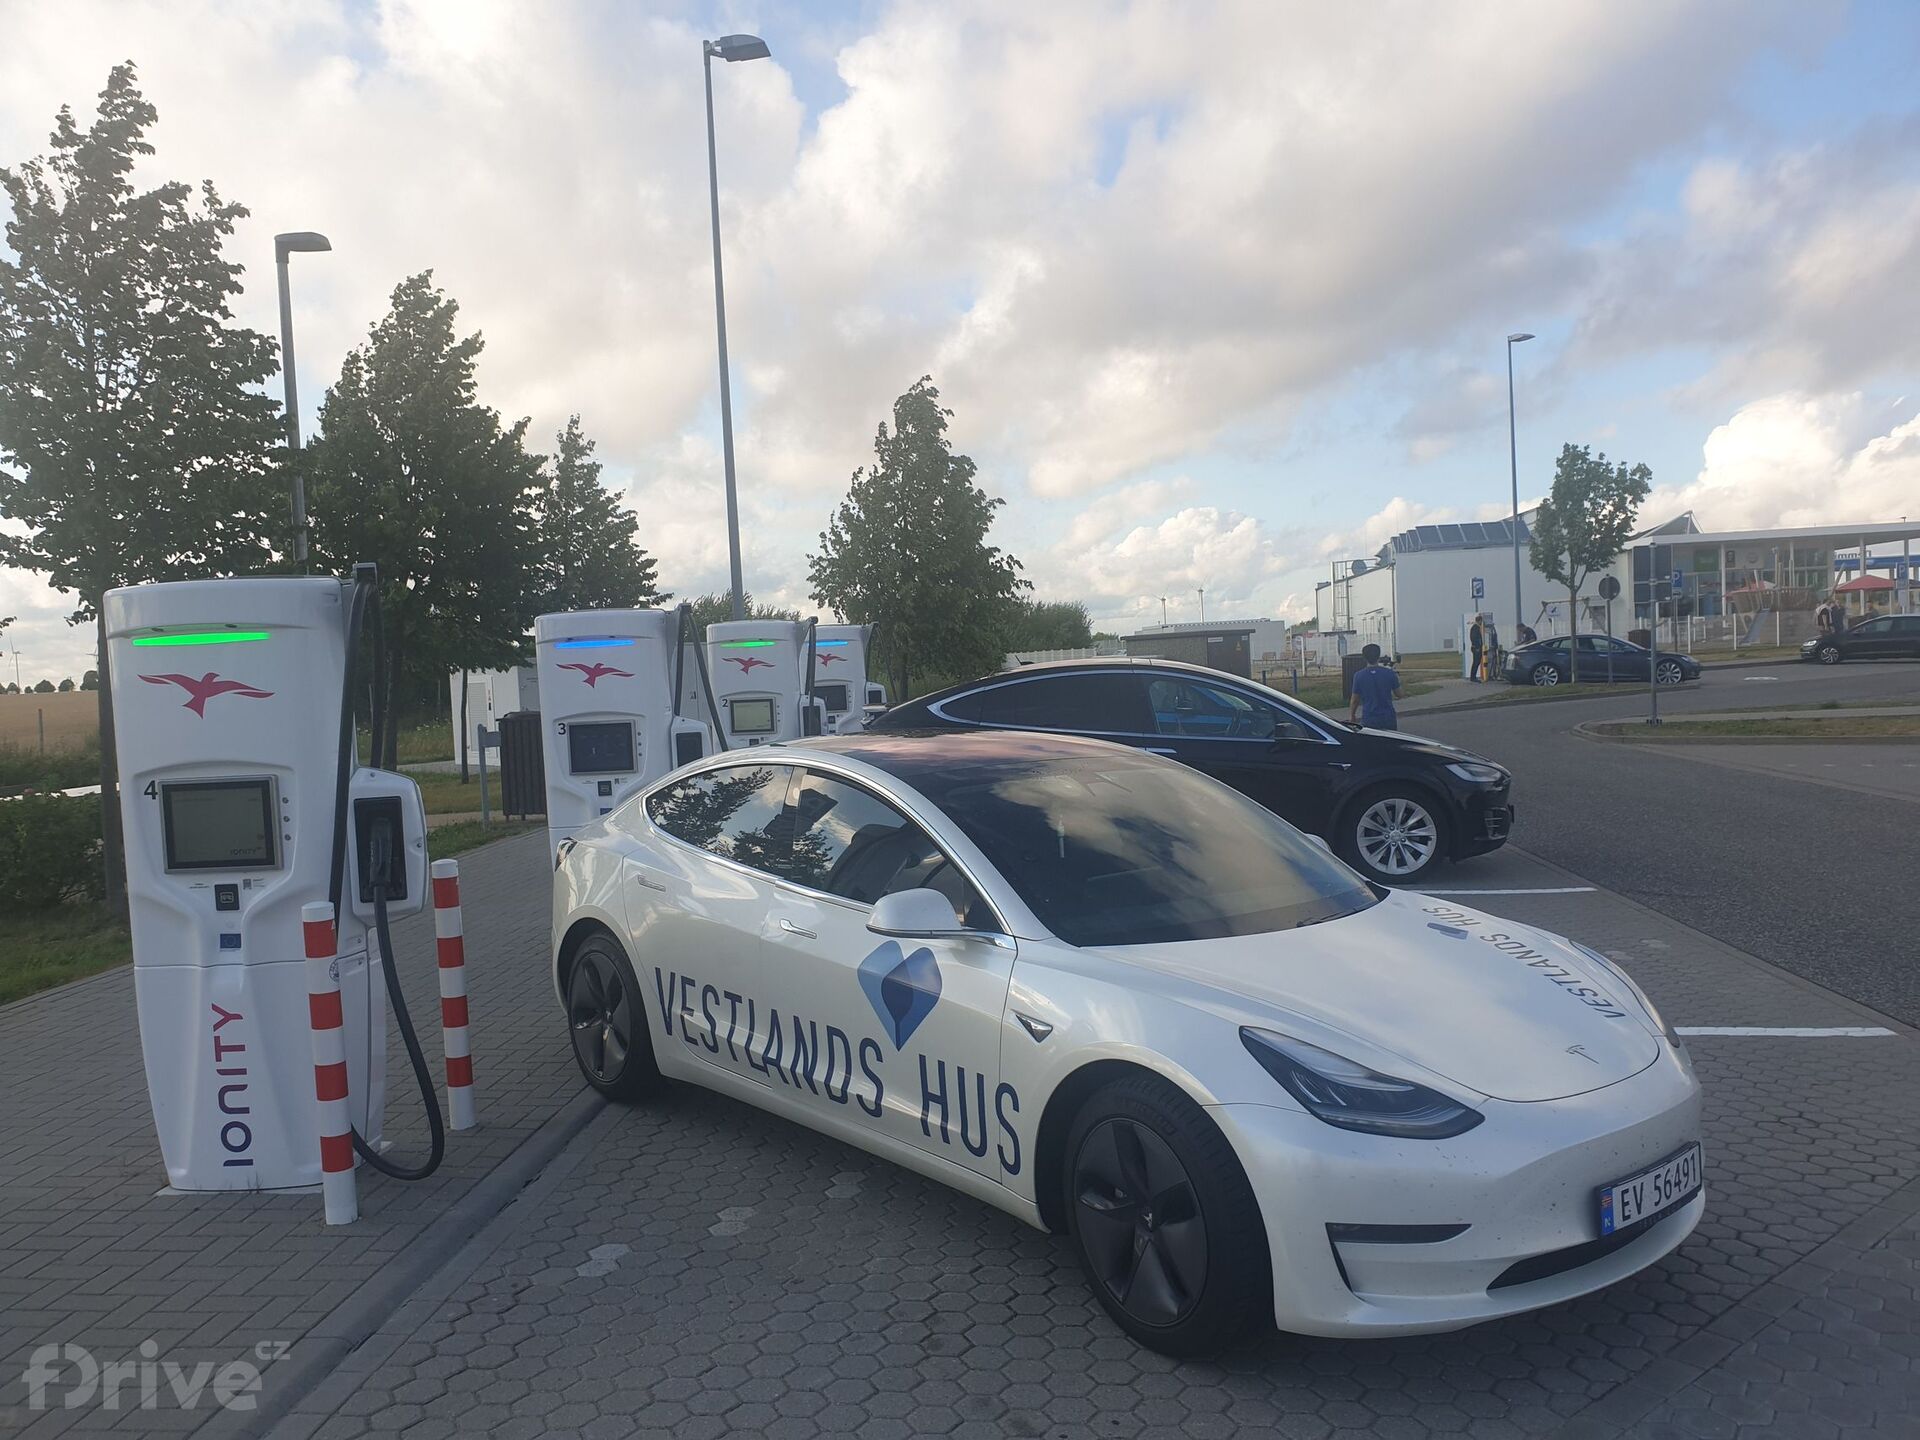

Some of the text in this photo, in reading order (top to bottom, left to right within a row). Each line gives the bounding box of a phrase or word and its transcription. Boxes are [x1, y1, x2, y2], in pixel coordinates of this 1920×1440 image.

[721, 699, 729, 708] 2
[557, 722, 567, 735] 3
[143, 780, 159, 800] 4
[1422, 906, 1626, 1019] VESTLANDS HUS
[211, 1002, 254, 1167] IONITY
[654, 966, 1022, 1176] VESTLANDS HUS
[1620, 1182, 1644, 1222] EV
[1653, 1152, 1696, 1207] 56491
[1604, 1216, 1611, 1228] N
